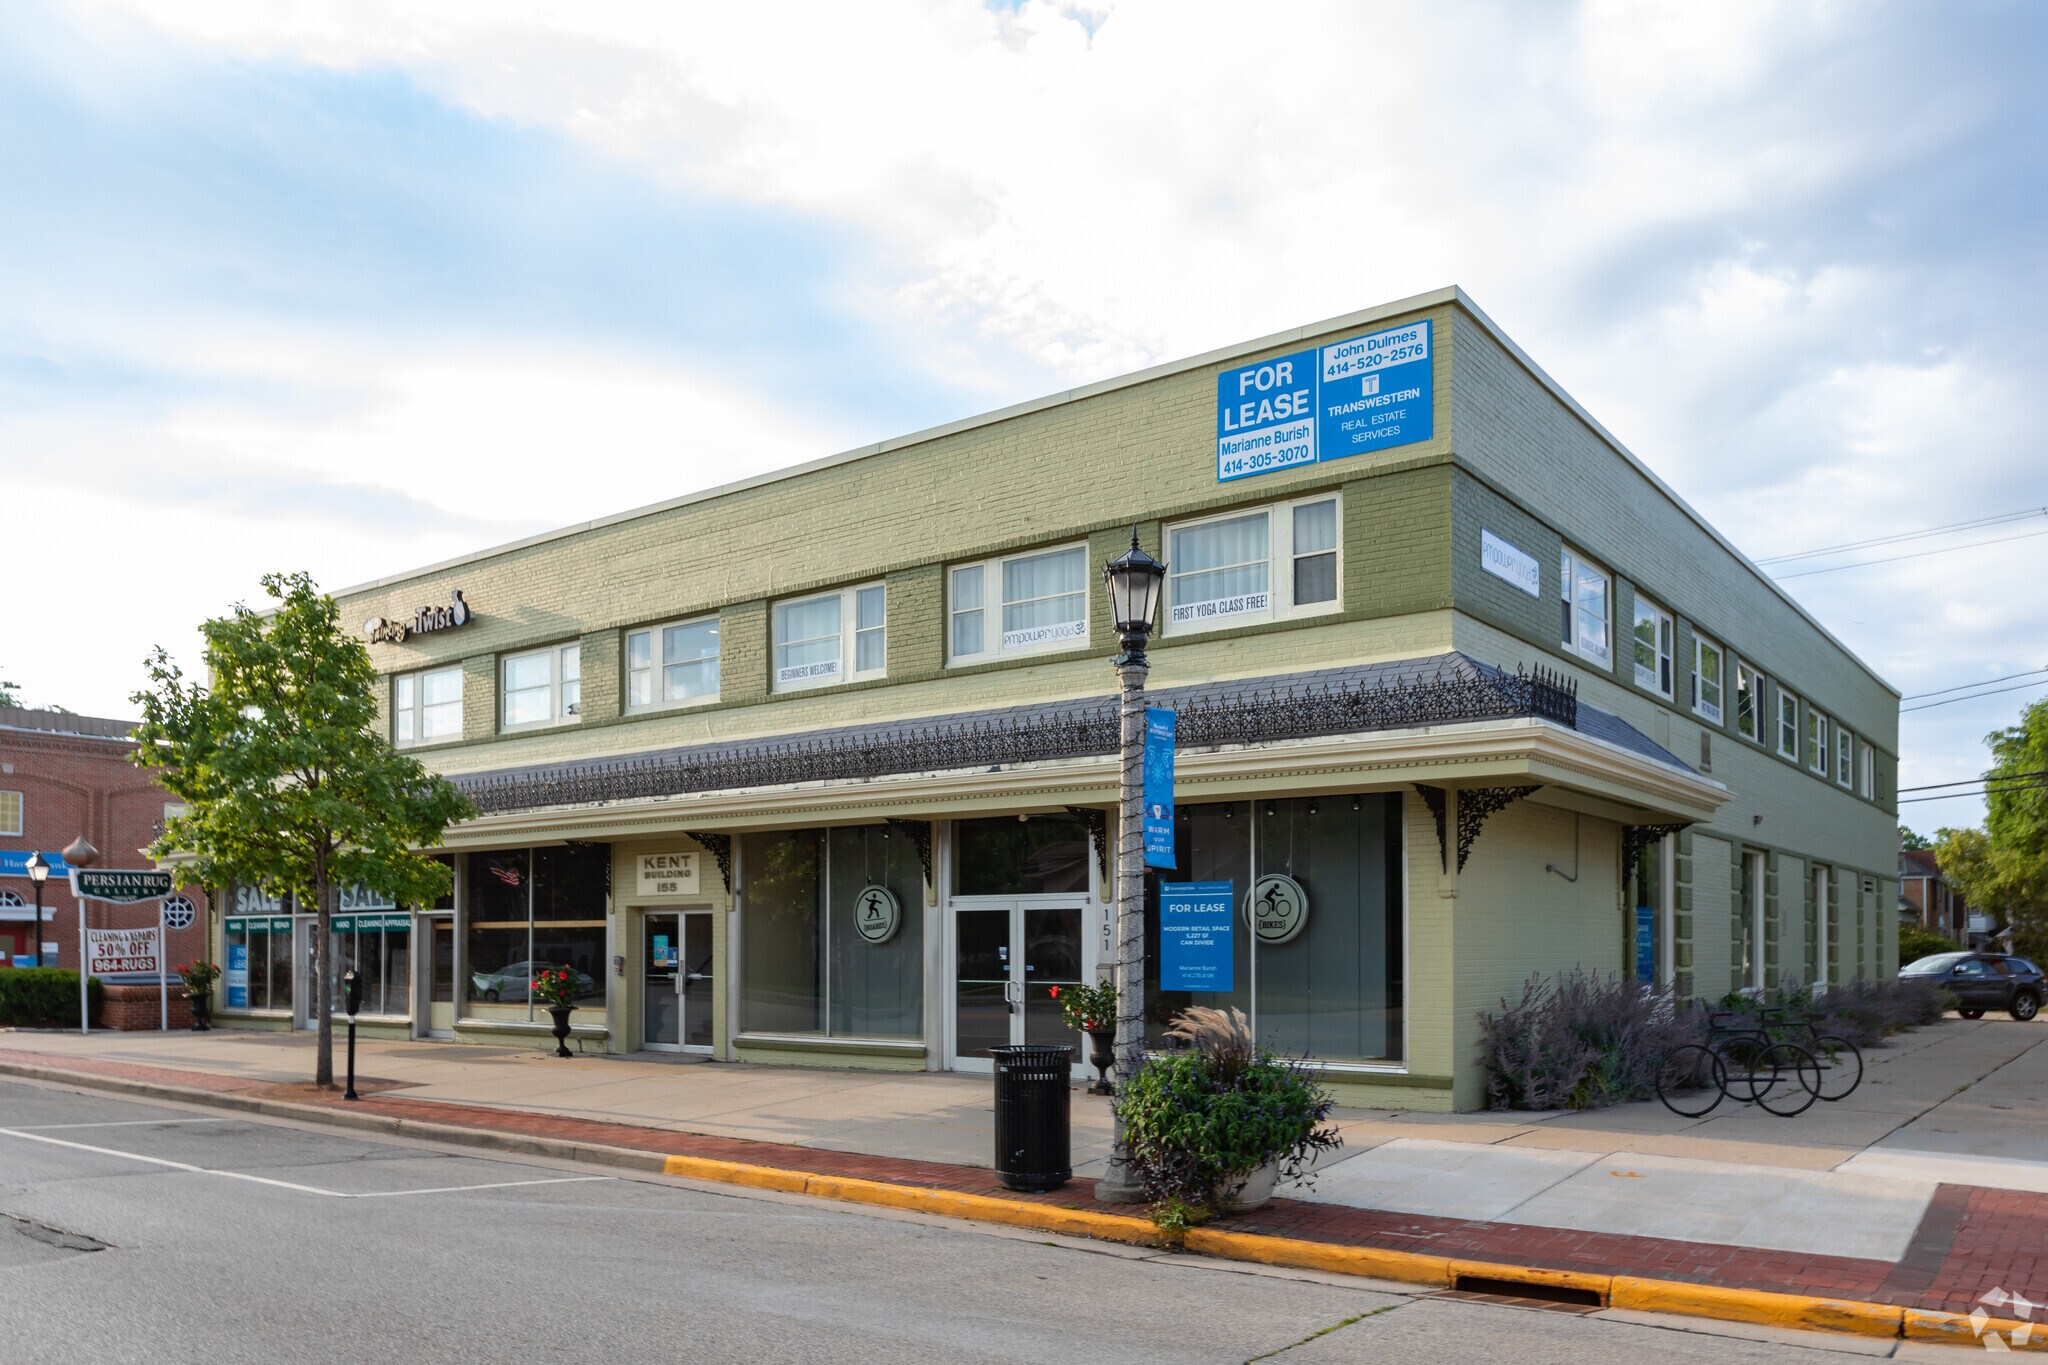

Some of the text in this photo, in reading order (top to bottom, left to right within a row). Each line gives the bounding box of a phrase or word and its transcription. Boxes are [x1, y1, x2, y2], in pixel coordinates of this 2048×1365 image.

[1334, 330, 1418, 360] John Dulmes
[1327, 344, 1424, 376] 414-520-2576
[1240, 362, 1293, 396] FOR
[1224, 389, 1309, 431] LEASE
[1328, 388, 1420, 417] TRANSWESTERN
[1342, 410, 1406, 431] REAL ESTATE
[1222, 425, 1310, 456] Marianne Burish
[1352, 426, 1400, 444] SERVICES
[1224, 444, 1308, 474] 414-305-3070
[1174, 594, 1268, 621] FIRST YOGA CLASS FREE!
[416, 606, 452, 633] Twist
[781, 662, 837, 680] BEGINNERS WELCOME!
[1148, 826, 1170, 834] WARM
[1146, 844, 1171, 853] SPIRIT
[644, 856, 691, 869] KENT
[83, 874, 169, 887] PERSIAN RUG
[644, 870, 692, 880] BUILDING
[656, 882, 678, 892] 155
[236, 886, 280, 912] SALE
[1169, 904, 1225, 912] FOR LEASE
[91, 932, 124, 942] CLEANING
[130, 930, 156, 942] REPAIRS
[98, 942, 150, 956] 50% OFF
[94, 958, 154, 971] 964-RUGS
